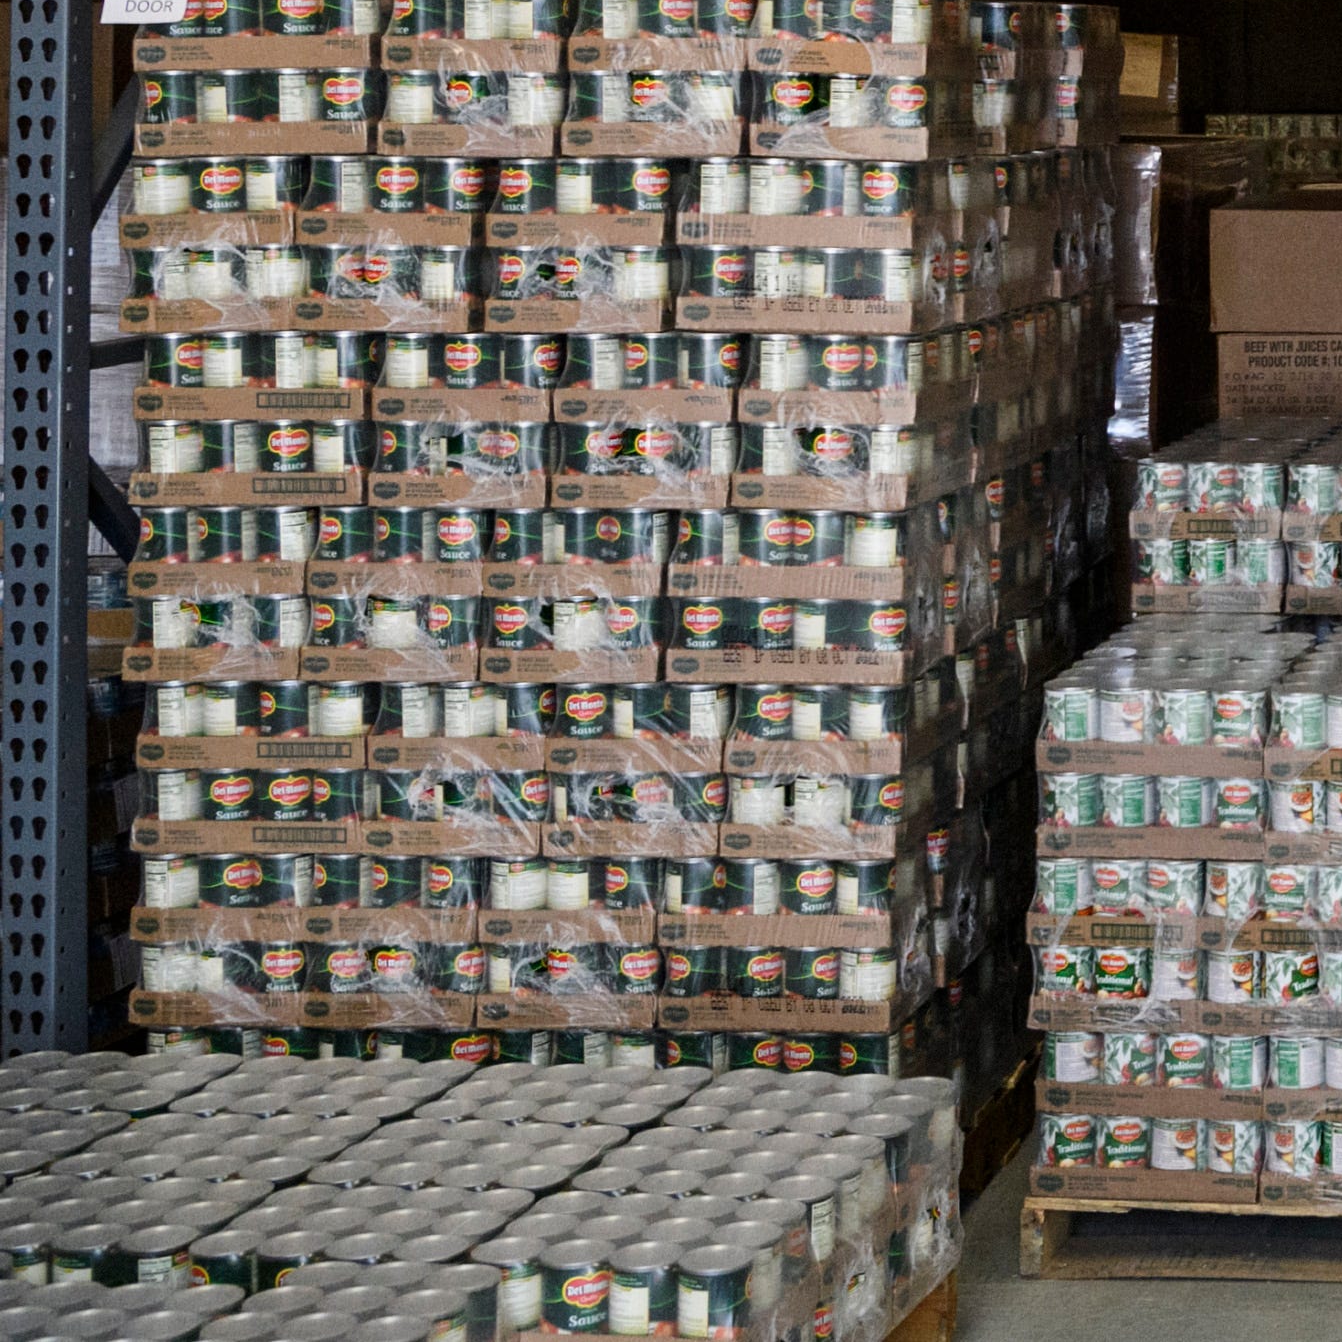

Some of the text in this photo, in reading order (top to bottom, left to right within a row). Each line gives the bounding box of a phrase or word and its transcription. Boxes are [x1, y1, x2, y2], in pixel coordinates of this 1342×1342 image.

[125, 0, 173, 13] DOOR
[283, 23, 316, 33] Sauce
[327, 110, 359, 120] Sauce
[206, 199, 240, 209] Sauce
[380, 199, 414, 209] Sauce
[1244, 340, 1267, 353] BEEF
[1269, 340, 1293, 353] WITH
[1296, 340, 1328, 353] JUICES
[1249, 355, 1291, 367] PRODUCT
[1294, 355, 1319, 367] CODE
[216, 809, 250, 820] Sauce
[274, 809, 308, 820] Sauce
[568, 1312, 606, 1328] Sauce
